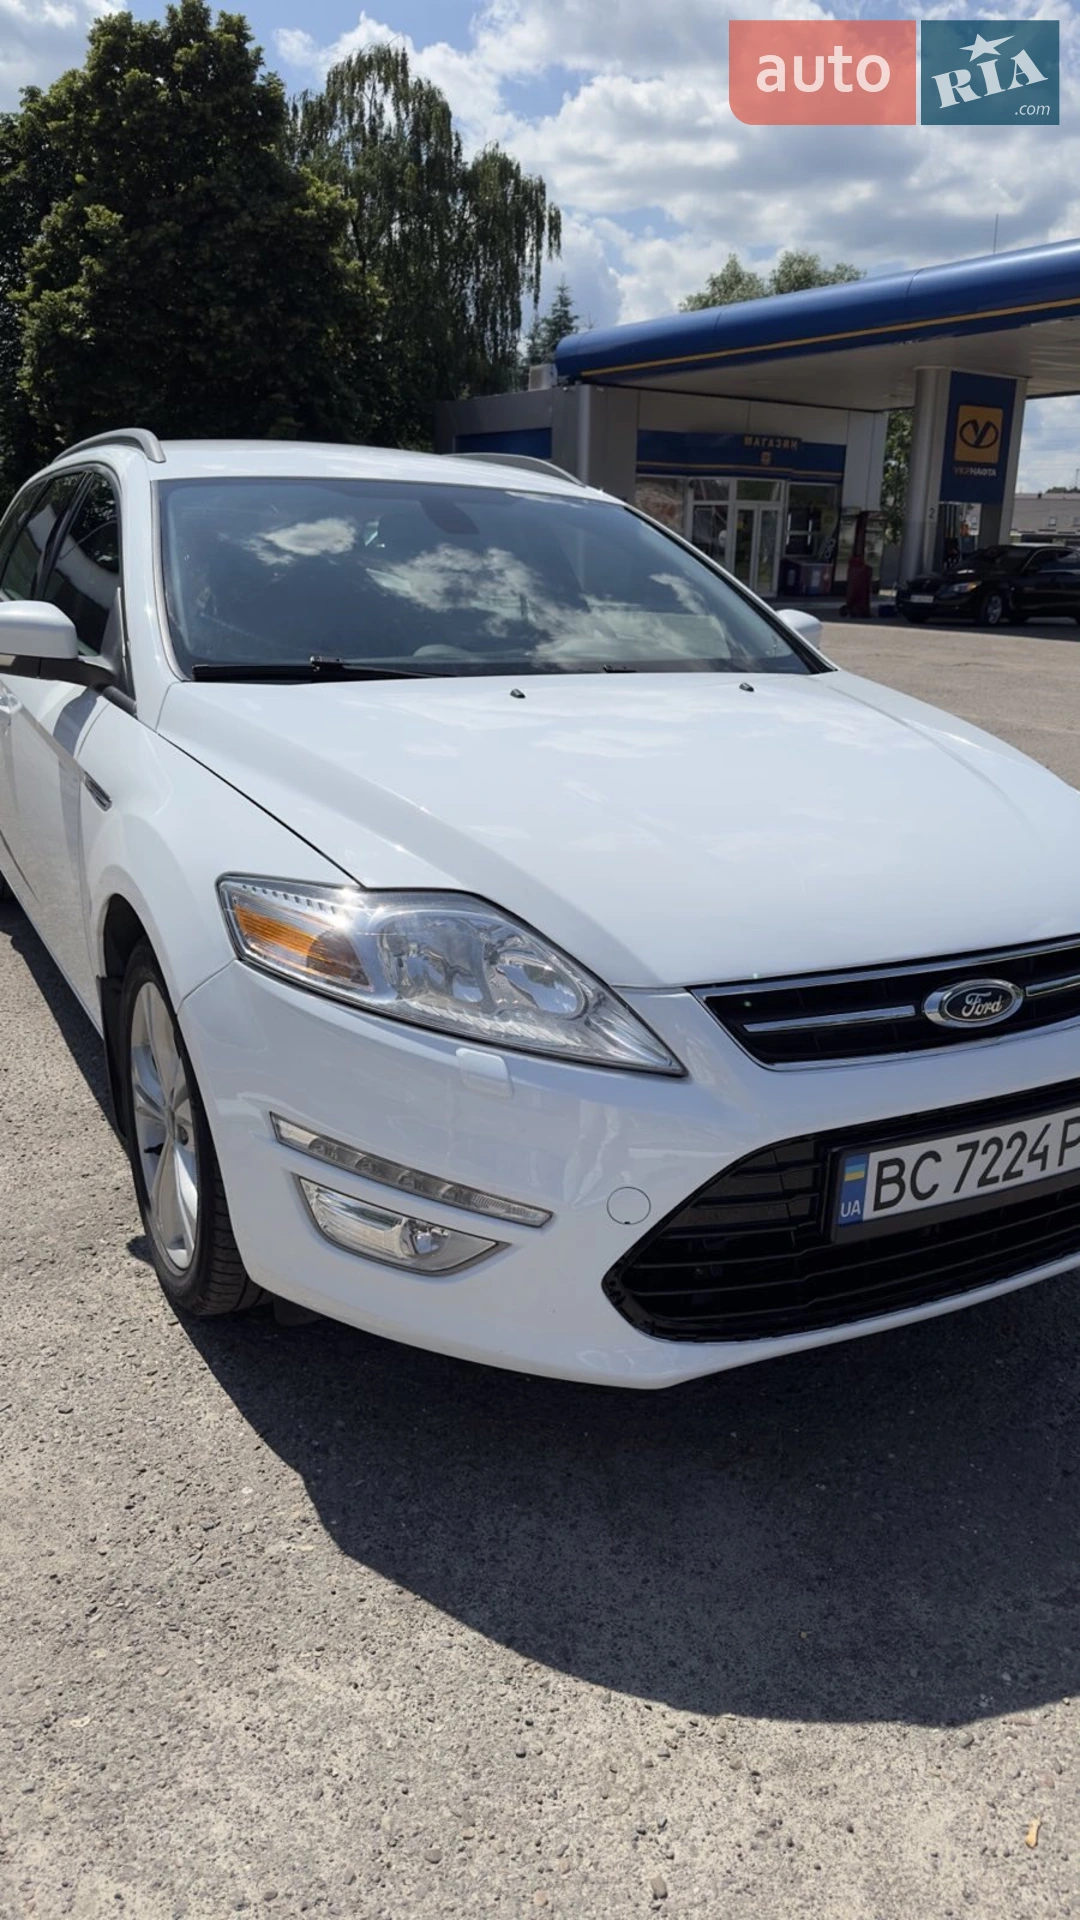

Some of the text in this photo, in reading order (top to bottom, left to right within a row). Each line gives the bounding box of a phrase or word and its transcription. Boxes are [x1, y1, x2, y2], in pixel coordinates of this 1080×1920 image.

[743, 435, 798, 450] МАГАЗИН
[953, 466, 997, 477] УКРНАФТА
[961, 992, 1002, 1018] Ford
[873, 1150, 942, 1212] BC
[953, 1122, 1052, 1194] 7224
[840, 1200, 861, 1218] UA
